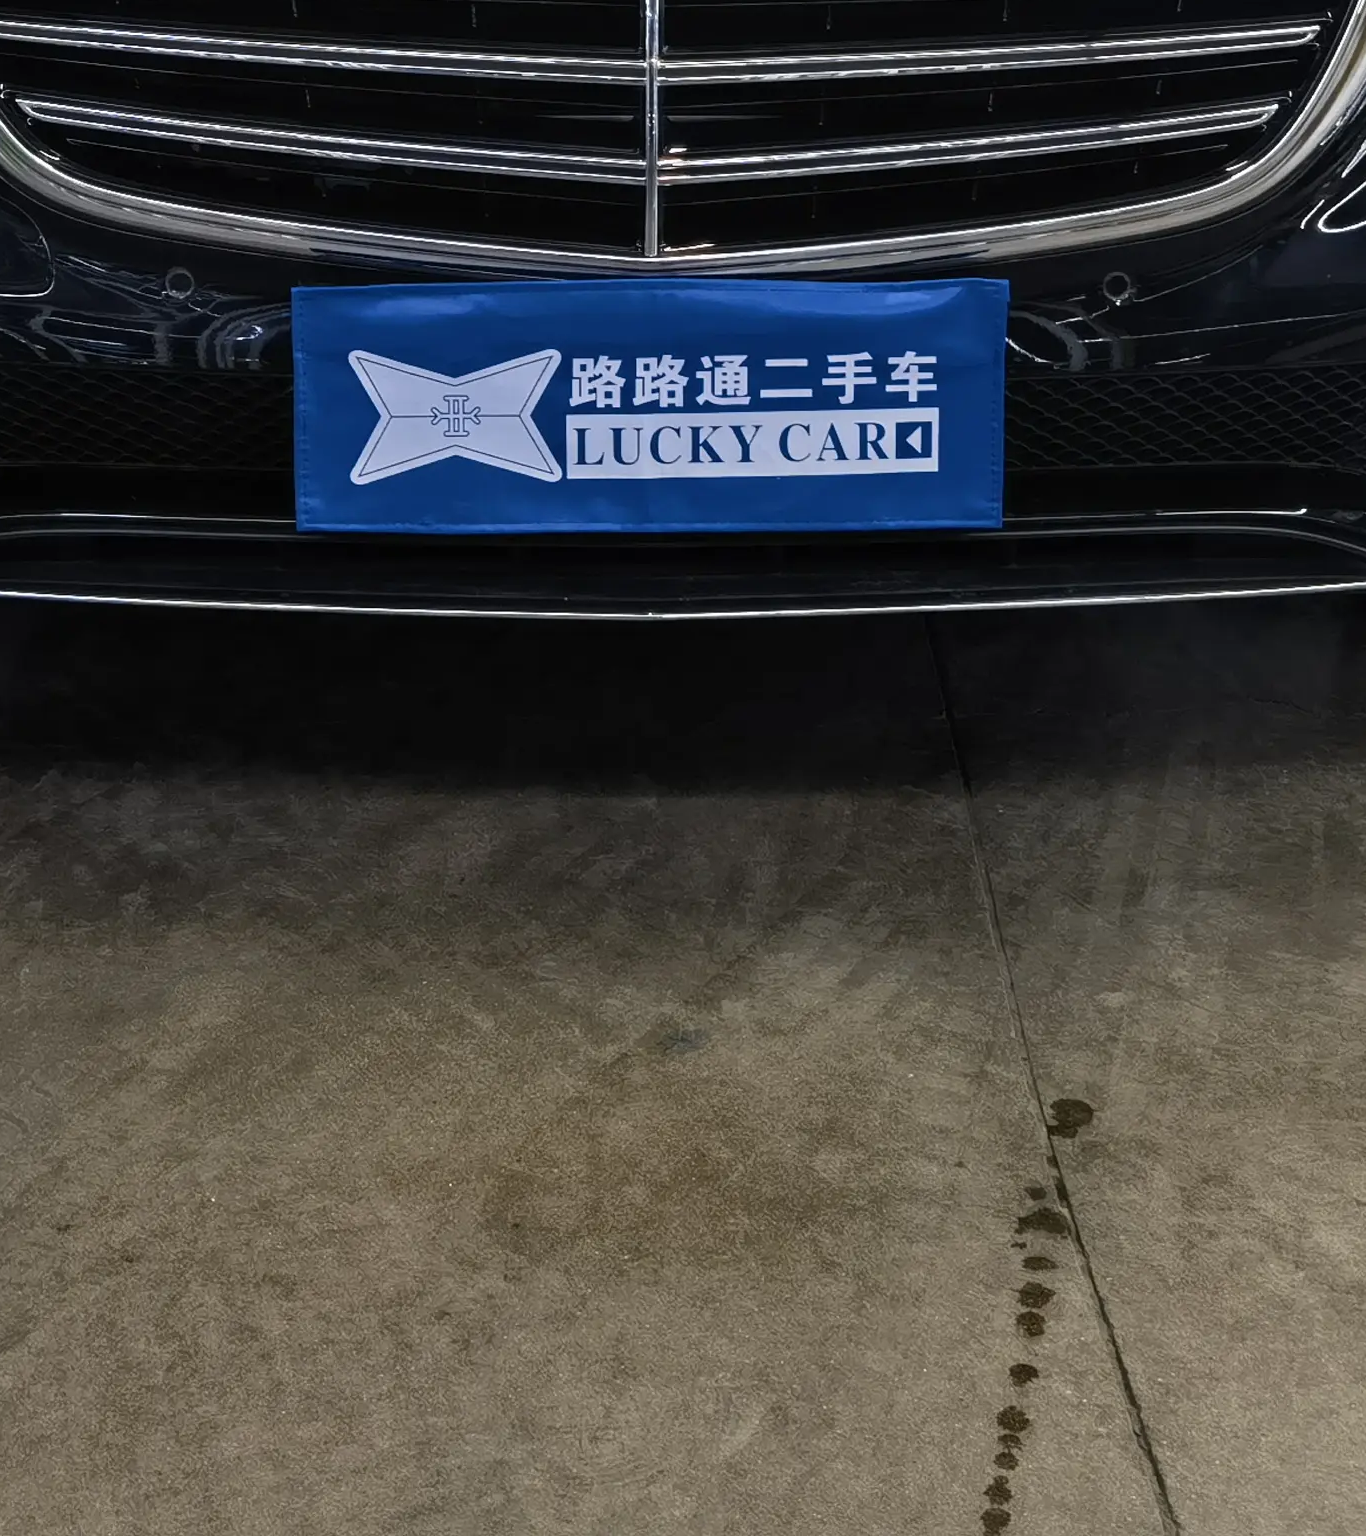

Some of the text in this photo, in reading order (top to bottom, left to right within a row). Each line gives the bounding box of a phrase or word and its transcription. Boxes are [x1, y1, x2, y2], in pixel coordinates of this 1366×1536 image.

[569, 351, 937, 408] 路路通二手车
[573, 422, 890, 465] LUCKY CAR
